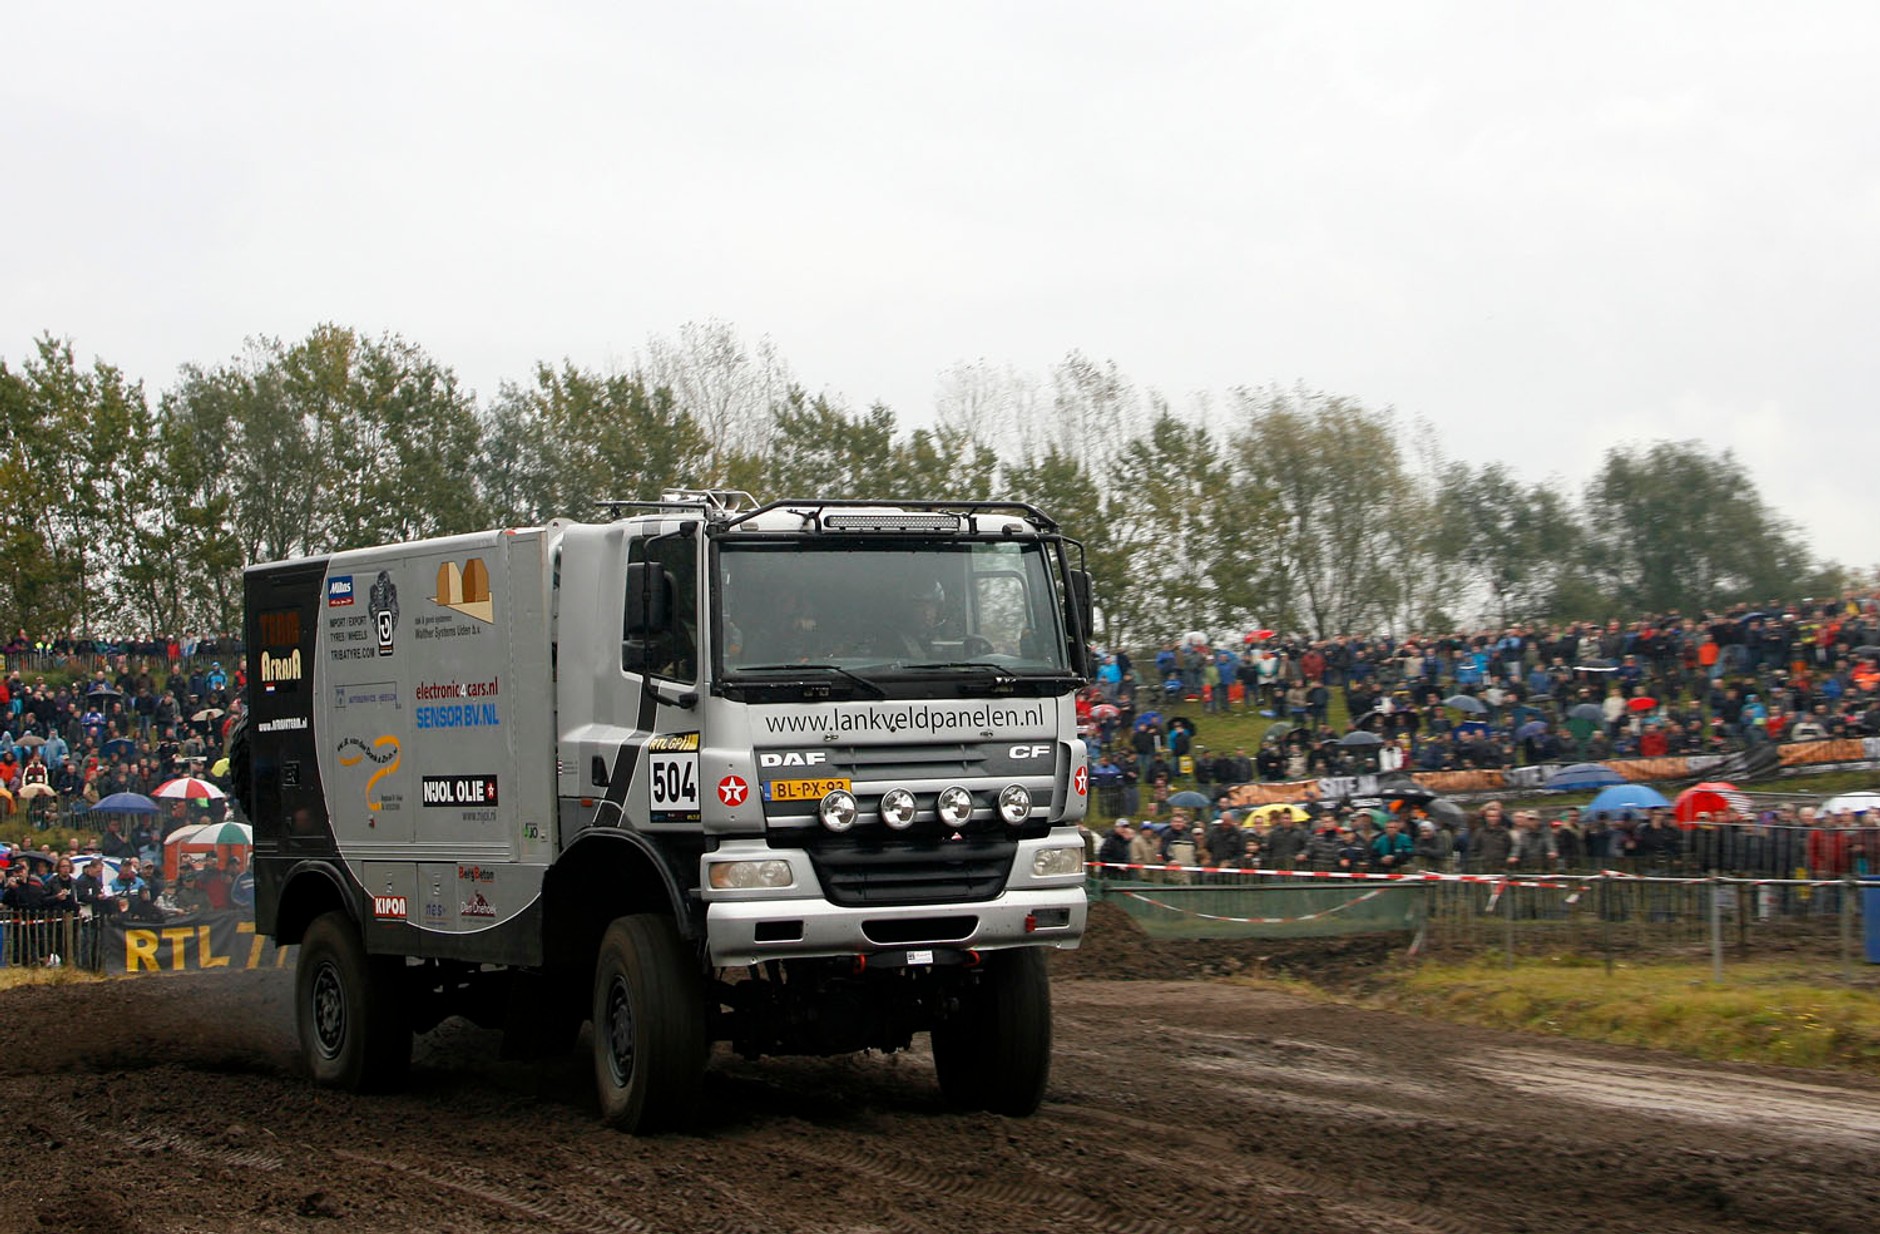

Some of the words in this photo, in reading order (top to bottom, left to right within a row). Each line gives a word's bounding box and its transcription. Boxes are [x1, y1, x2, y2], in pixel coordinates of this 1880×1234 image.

[416, 676, 498, 700] electronic4cars.nl
[765, 703, 1044, 734] www.lankveldpanelen.nl
[759, 752, 826, 767] DAF
[1008, 745, 1051, 759] CF
[456, 780, 485, 802] OLIE
[653, 761, 696, 803] 504
[125, 925, 231, 973] RTL
